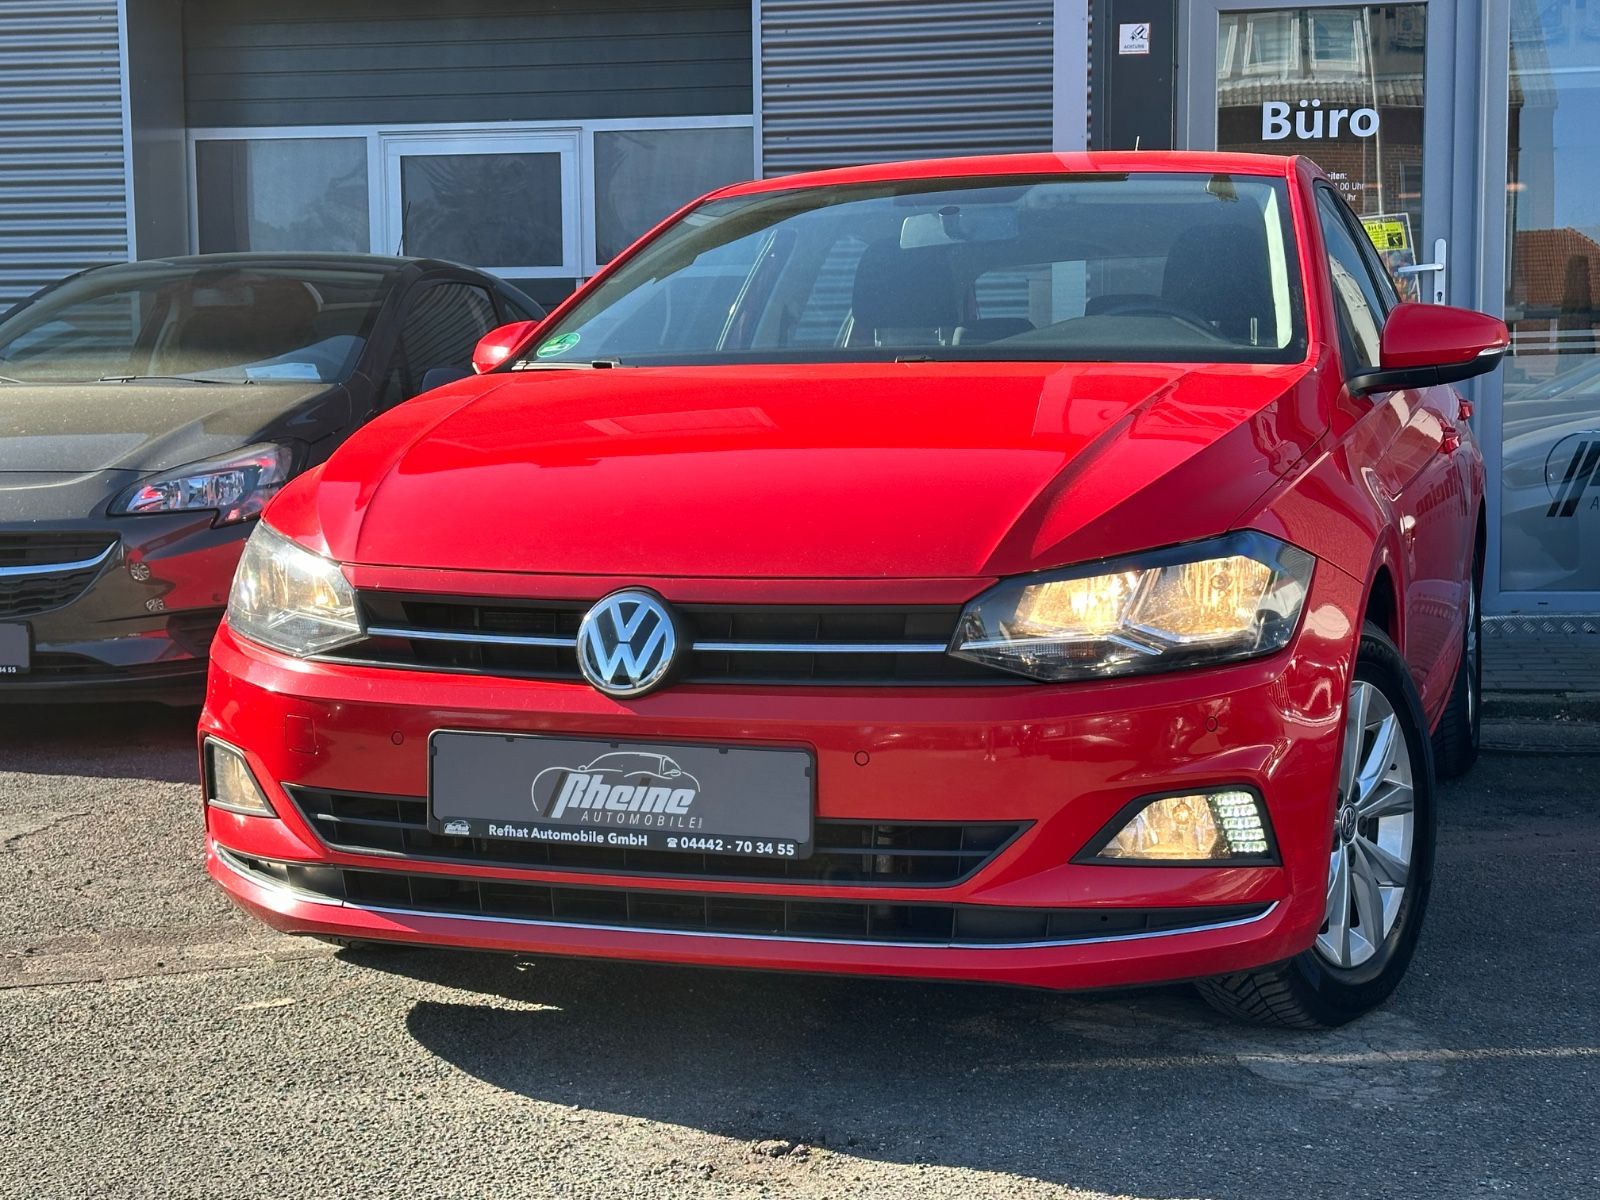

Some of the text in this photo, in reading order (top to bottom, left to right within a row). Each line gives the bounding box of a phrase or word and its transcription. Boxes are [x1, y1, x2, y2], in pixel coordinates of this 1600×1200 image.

[1262, 98, 1380, 140] Büro
[1351, 182, 1364, 190] Uhr
[551, 773, 696, 818] Rheine
[581, 810, 697, 829] AUTOMOBILE
[488, 824, 529, 838] Refhat
[531, 827, 605, 843] Automobile
[607, 832, 648, 846] GmbH
[680, 837, 724, 851] 04442
[735, 840, 752, 853] 70
[755, 842, 774, 854] 34
[777, 843, 795, 856] 55
